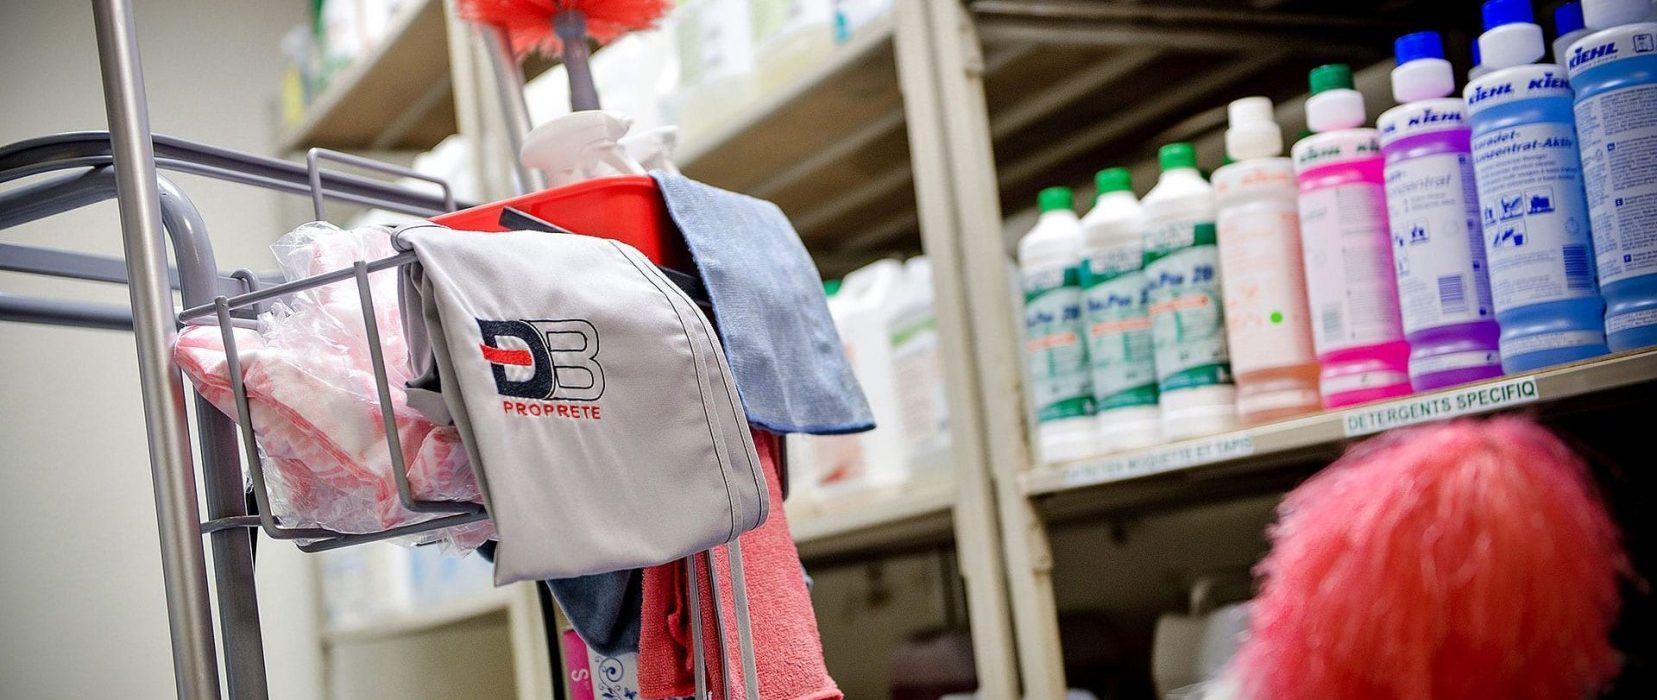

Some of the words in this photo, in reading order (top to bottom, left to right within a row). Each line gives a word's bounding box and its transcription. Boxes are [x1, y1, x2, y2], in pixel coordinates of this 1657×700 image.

[1568, 42, 1618, 70] KIEHL
[1467, 81, 1513, 106] KIEHL
[1527, 72, 1572, 90] KIEH
[475, 315, 605, 401] DB
[503, 400, 602, 420] PROPRETE
[1347, 397, 1452, 431] DETERGENTS
[1456, 380, 1536, 410] SPECIFIQ
